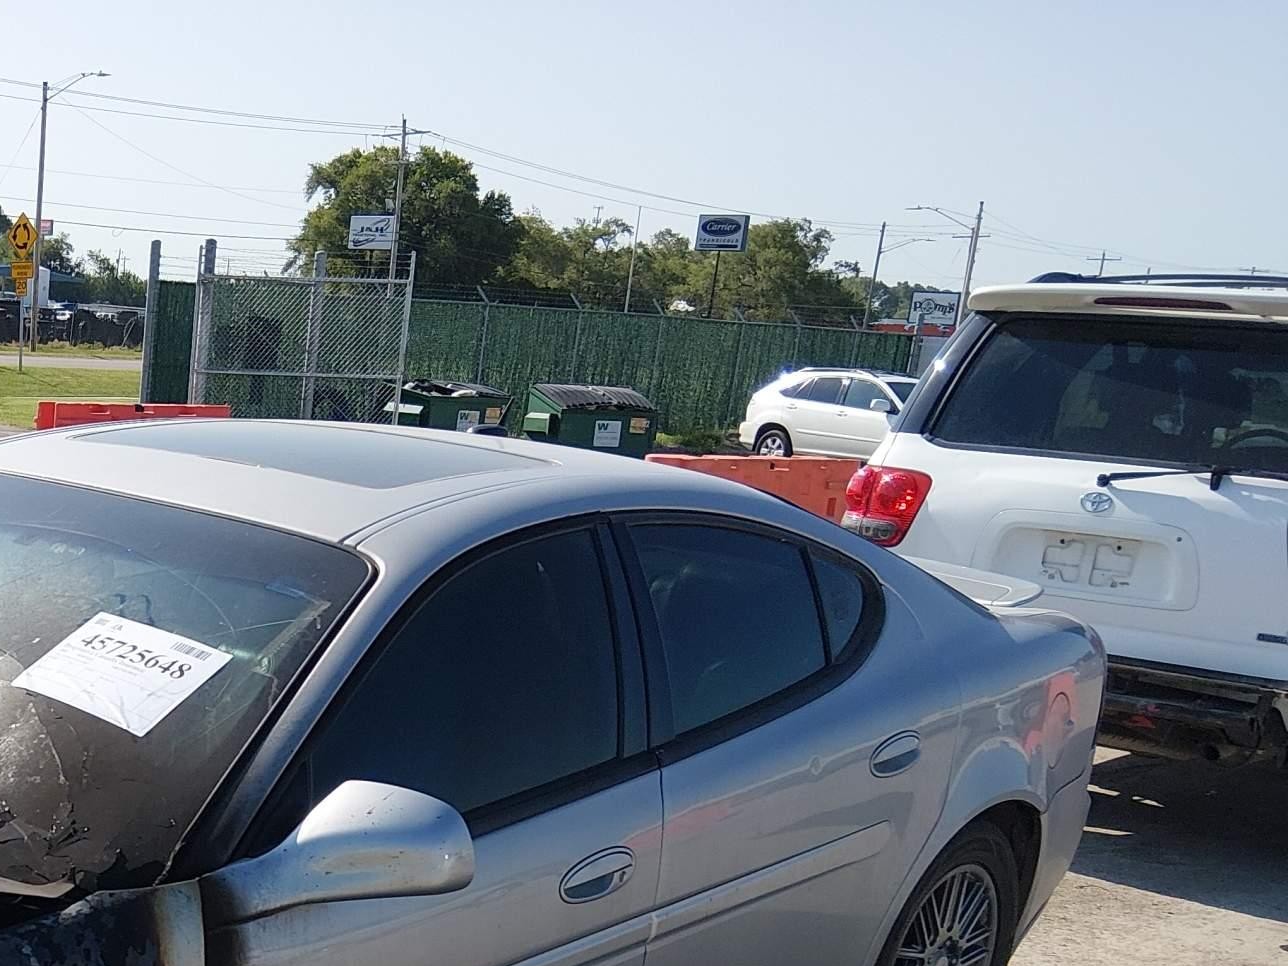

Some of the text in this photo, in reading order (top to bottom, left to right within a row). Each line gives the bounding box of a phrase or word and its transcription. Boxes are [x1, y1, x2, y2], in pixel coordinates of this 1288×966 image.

[706, 221, 737, 231] Carrier
[17, 281, 27, 290] 20
[81, 634, 192, 679] 45725648
